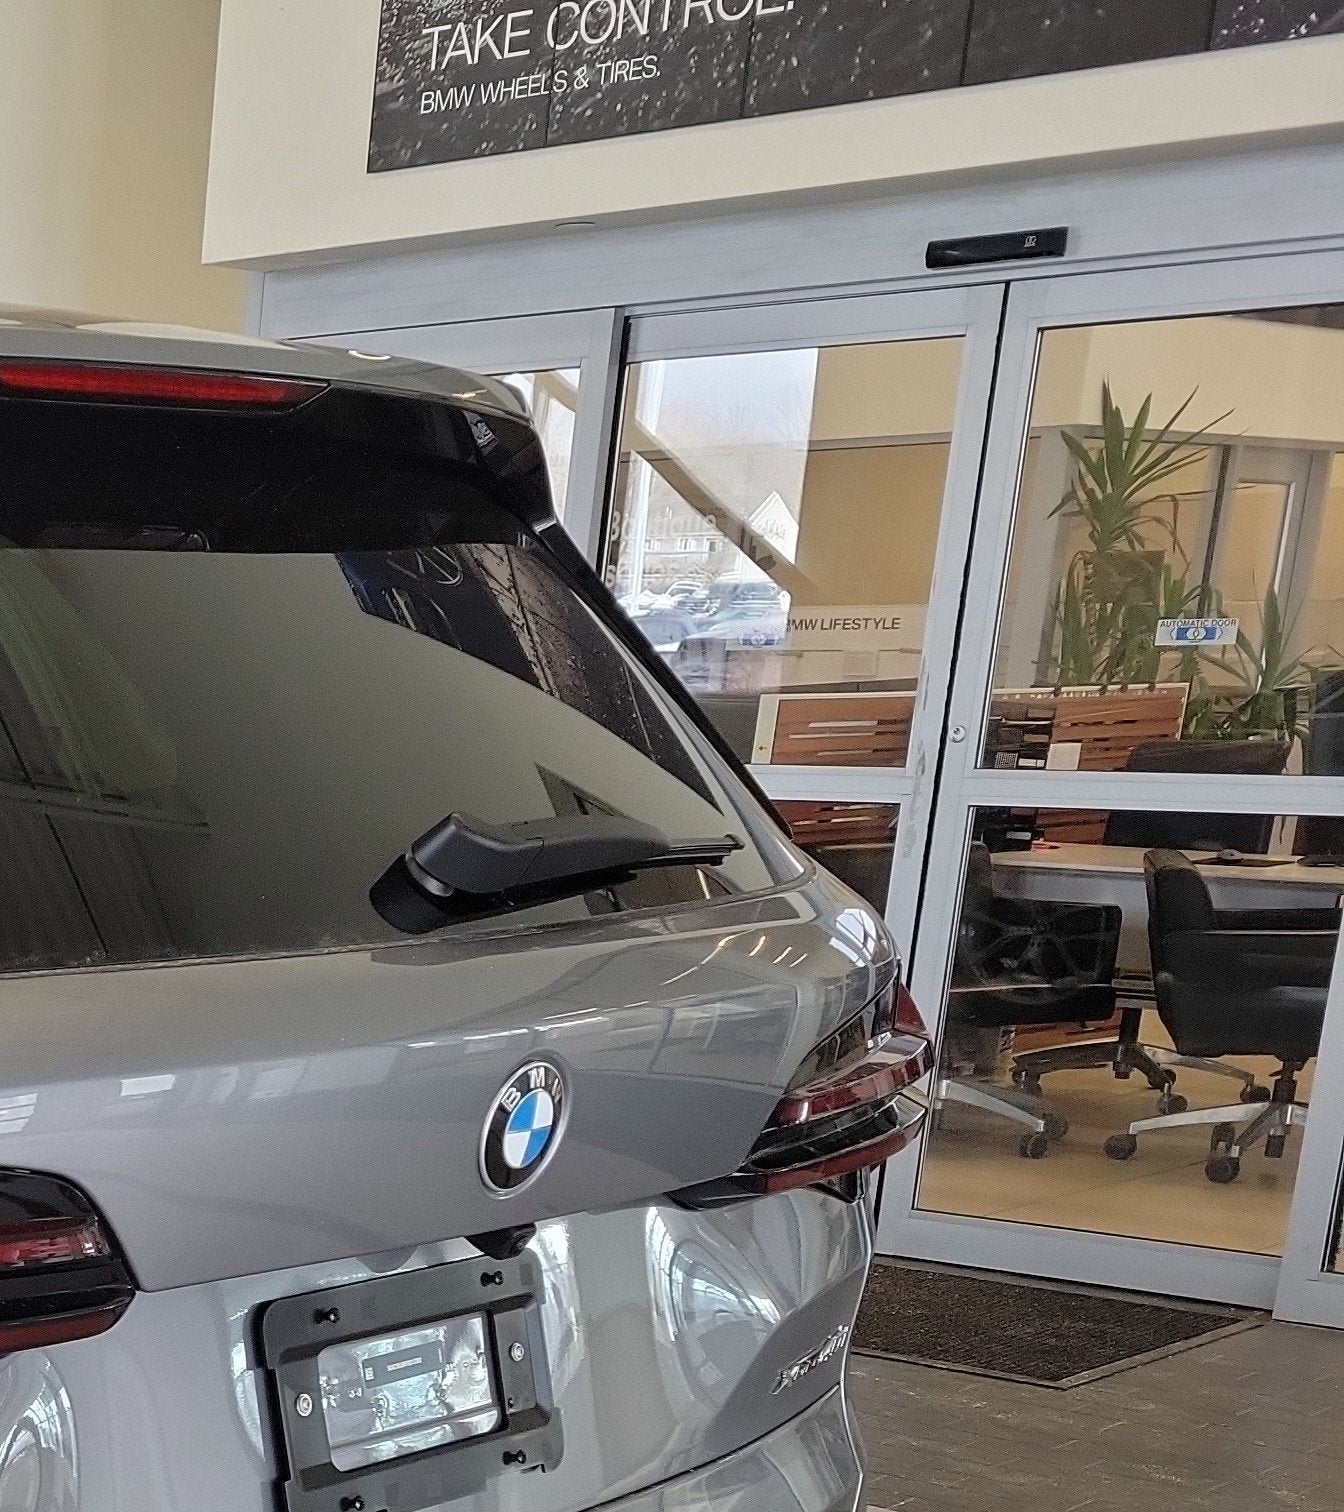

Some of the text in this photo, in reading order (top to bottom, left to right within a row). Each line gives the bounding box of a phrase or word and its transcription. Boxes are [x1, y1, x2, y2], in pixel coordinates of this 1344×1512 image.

[421, 9, 535, 72] TAKE
[420, 55, 661, 115] BMW WHEELS & TIRES.
[820, 617, 902, 631] LIFESTYLE
[1160, 619, 1237, 628] AUTOMATIC DOOR
[500, 1065, 563, 1113] BMW
